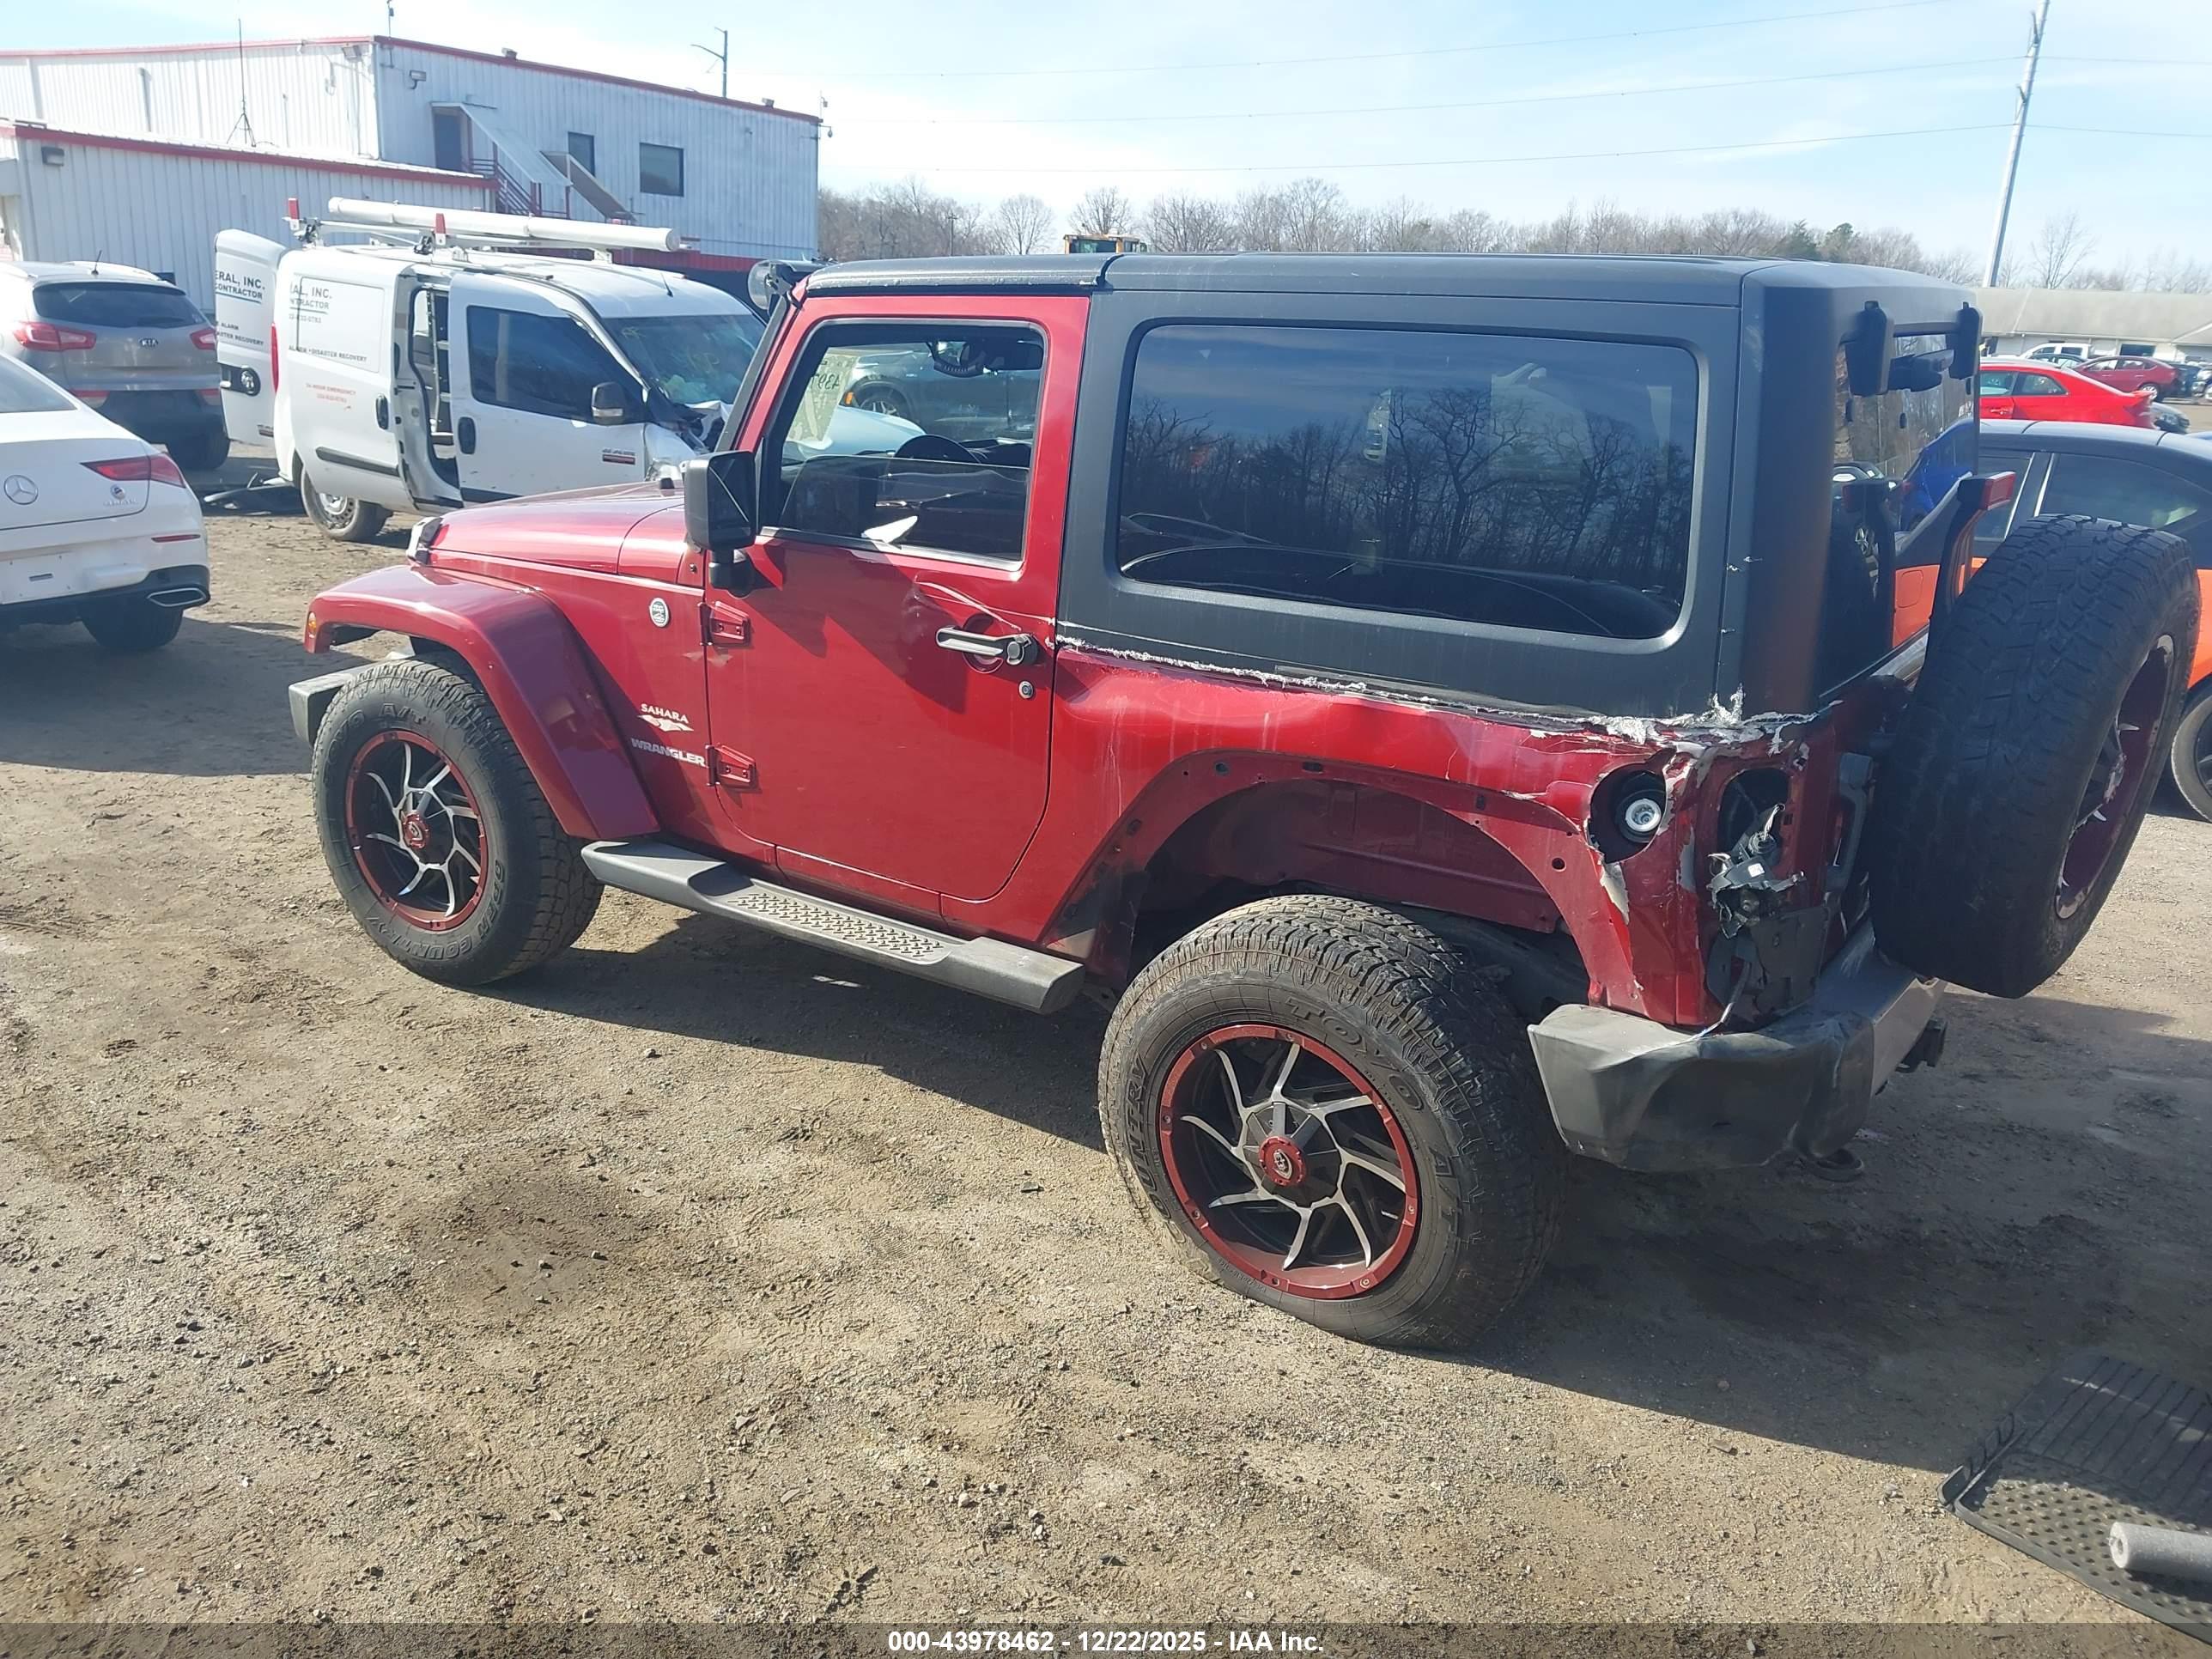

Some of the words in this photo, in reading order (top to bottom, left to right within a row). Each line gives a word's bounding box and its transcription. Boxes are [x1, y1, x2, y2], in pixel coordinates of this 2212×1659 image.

[243, 276, 265, 290] INC.
[311, 287, 332, 300] INC.
[234, 334, 264, 346] RECOVERY
[338, 353, 368, 362] RECOVERY
[641, 703, 689, 724] SAHARA
[630, 738, 708, 769] WRANGLER
[477, 859, 507, 941] OPEN
[1285, 996, 1425, 1112] TOYO
[1124, 1053, 1187, 1245] COUNTRY
